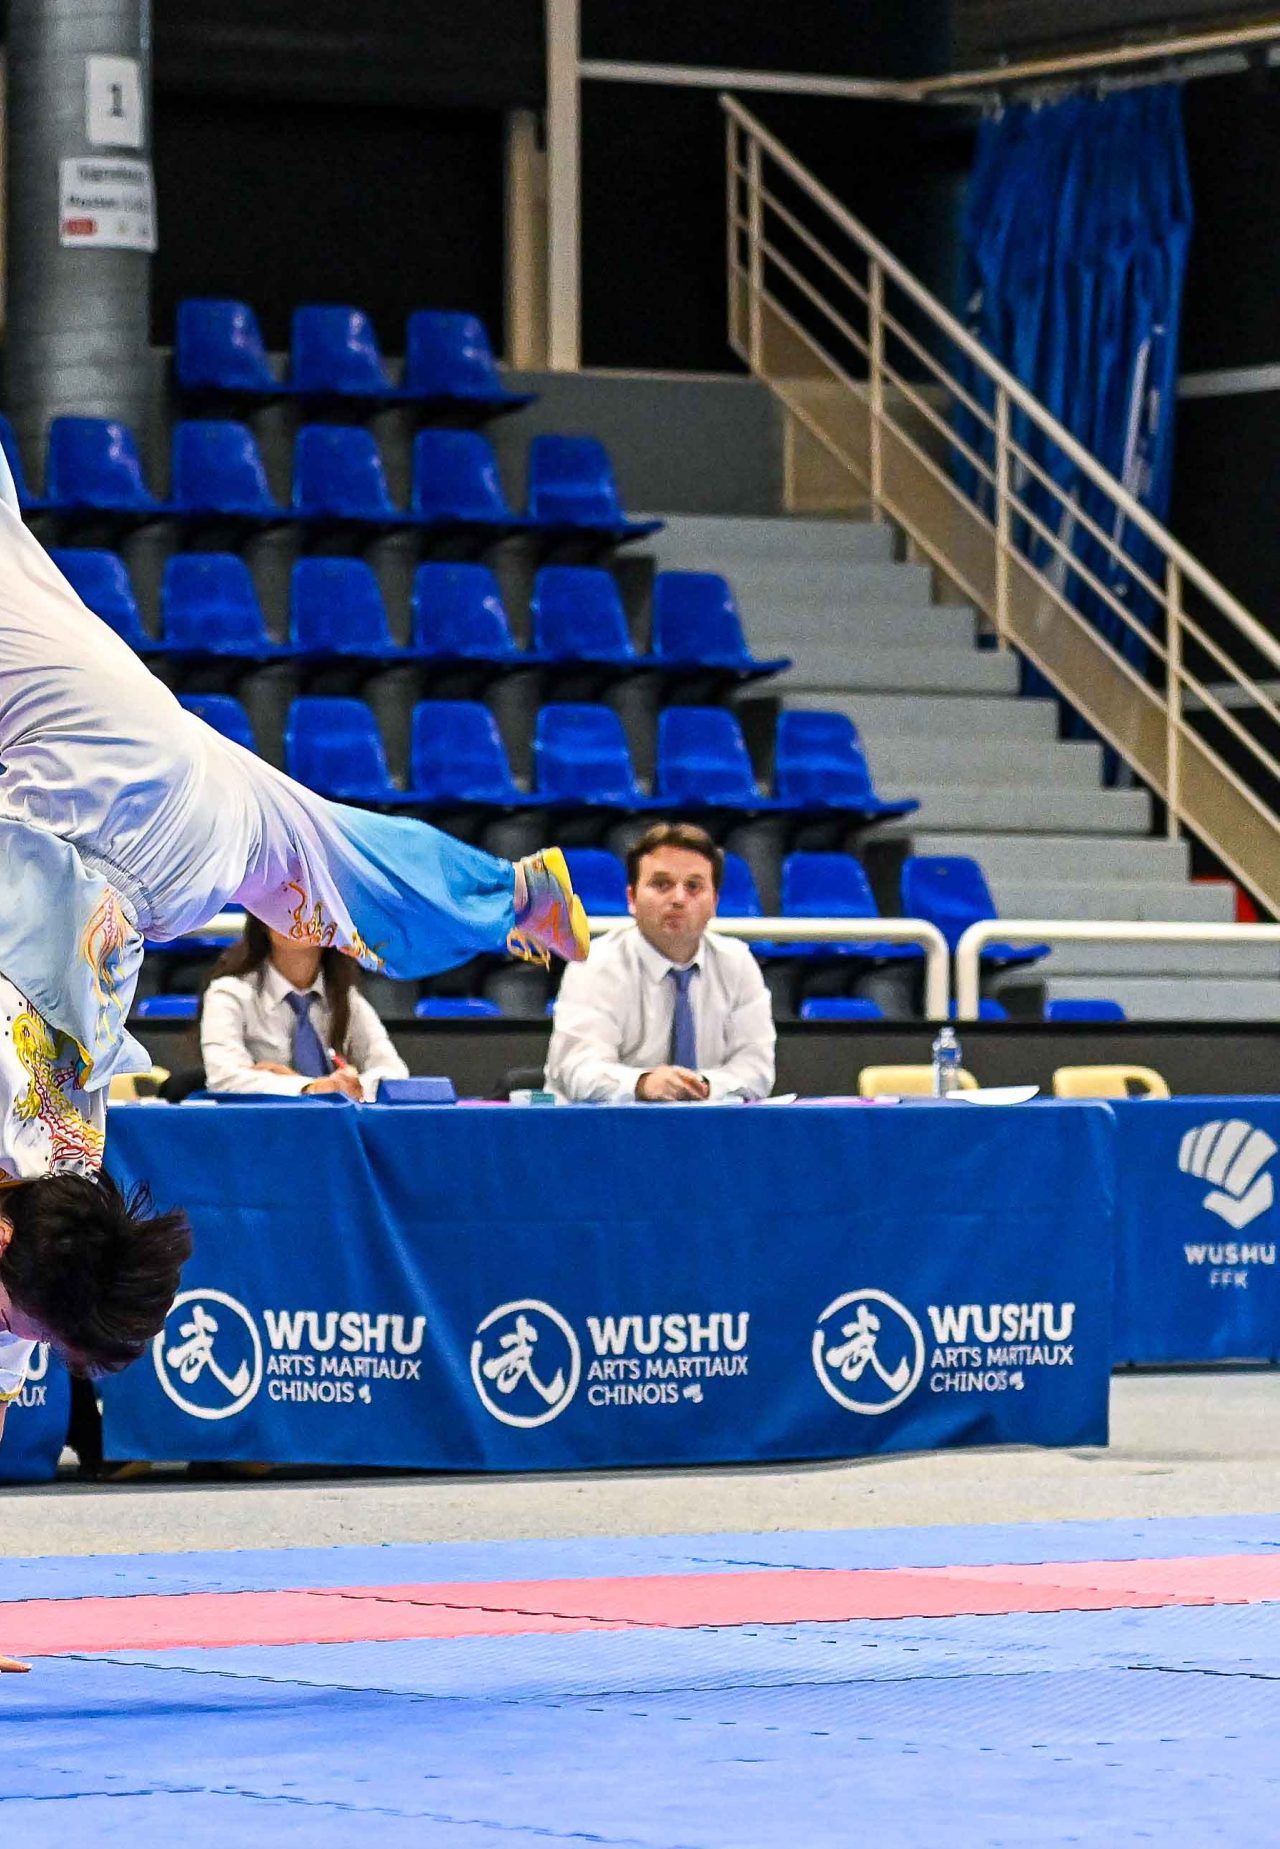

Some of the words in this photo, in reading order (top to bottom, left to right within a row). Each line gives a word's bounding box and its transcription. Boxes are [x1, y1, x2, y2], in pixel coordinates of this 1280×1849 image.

[1183, 1242, 1276, 1265] WUSHU
[263, 1309, 426, 1355] WUSHU
[586, 1311, 750, 1355] WUSHU
[927, 1302, 1076, 1344] WUSHU
[266, 1354, 316, 1377] ARTS
[321, 1355, 422, 1380] MARTIAUX
[586, 1358, 641, 1381] ARTS
[645, 1355, 749, 1379] MARTIAUX
[930, 1346, 982, 1369] ARTS
[986, 1344, 1075, 1367] MARTIAUX
[268, 1379, 355, 1403] CHINOIS
[587, 1382, 679, 1406] CHINOIS
